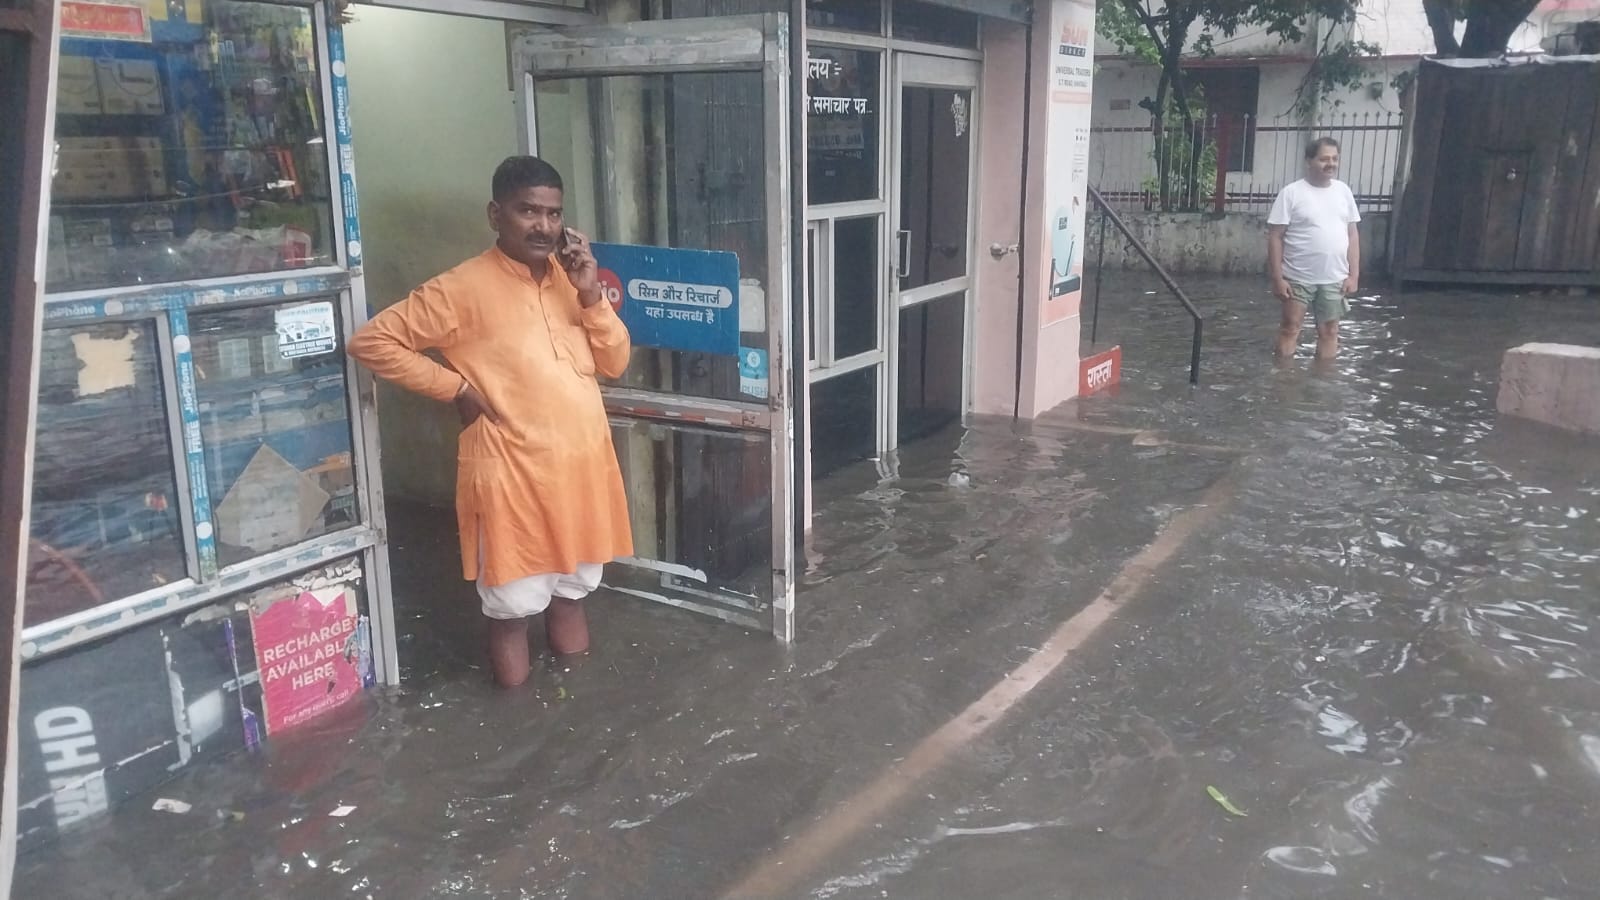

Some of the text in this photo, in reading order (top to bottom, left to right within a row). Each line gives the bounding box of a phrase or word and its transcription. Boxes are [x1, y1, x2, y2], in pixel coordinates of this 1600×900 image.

[813, 96, 851, 114] समाचार
[638, 283, 721, 305] सिम और रिचार्ज
[645, 304, 715, 325] यहां उपलब्ध है
[1087, 358, 1113, 389] रास्ता
[263, 617, 351, 664] RECHARGE
[291, 661, 337, 691] HERE
[33, 705, 100, 772] HD
